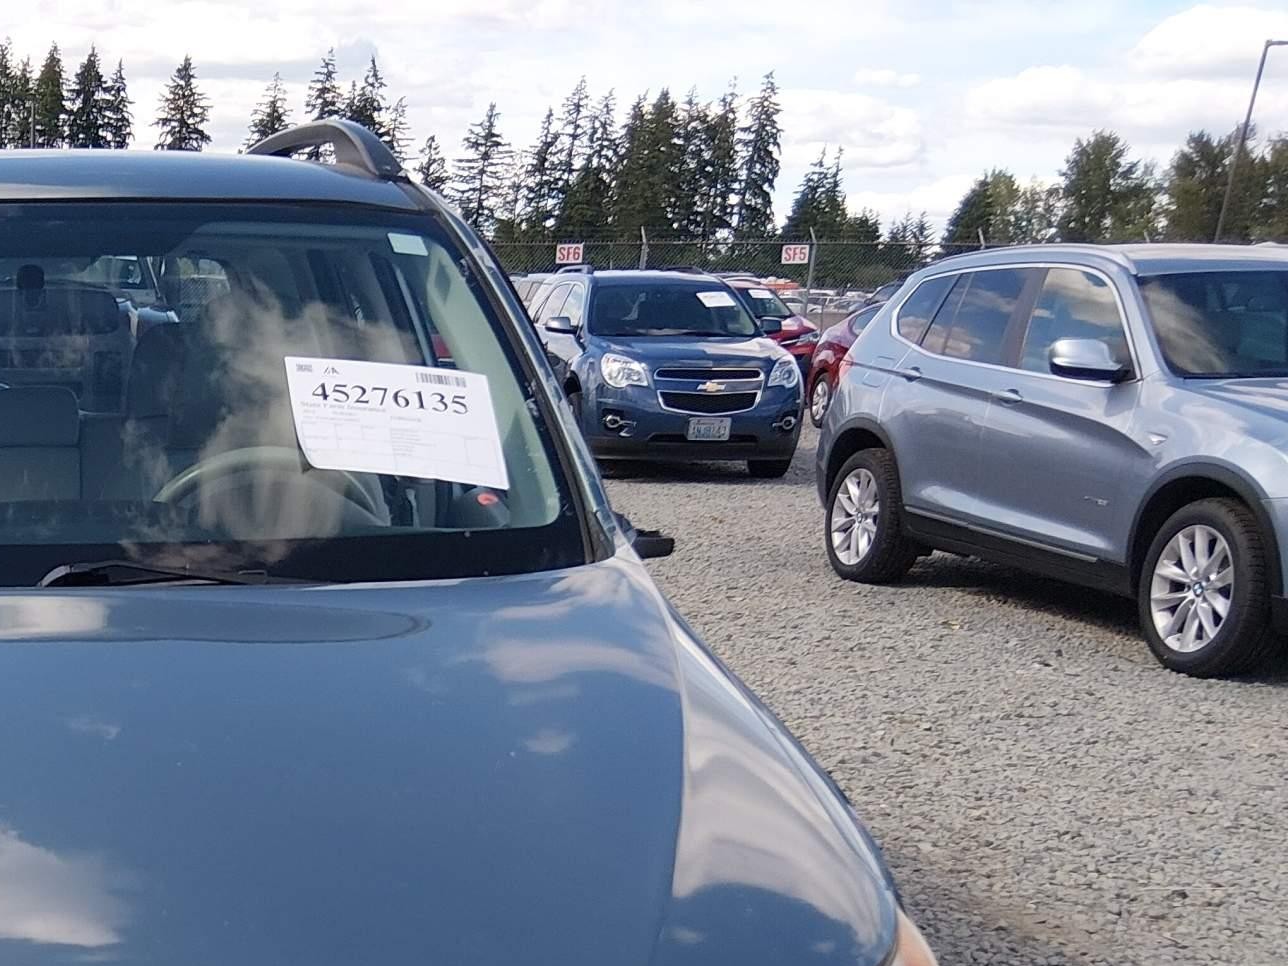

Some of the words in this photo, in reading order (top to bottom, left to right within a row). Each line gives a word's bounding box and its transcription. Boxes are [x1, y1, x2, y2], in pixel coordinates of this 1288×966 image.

[558, 246, 581, 262] SF6
[784, 247, 807, 262] SF5
[312, 382, 468, 415] 45276135
